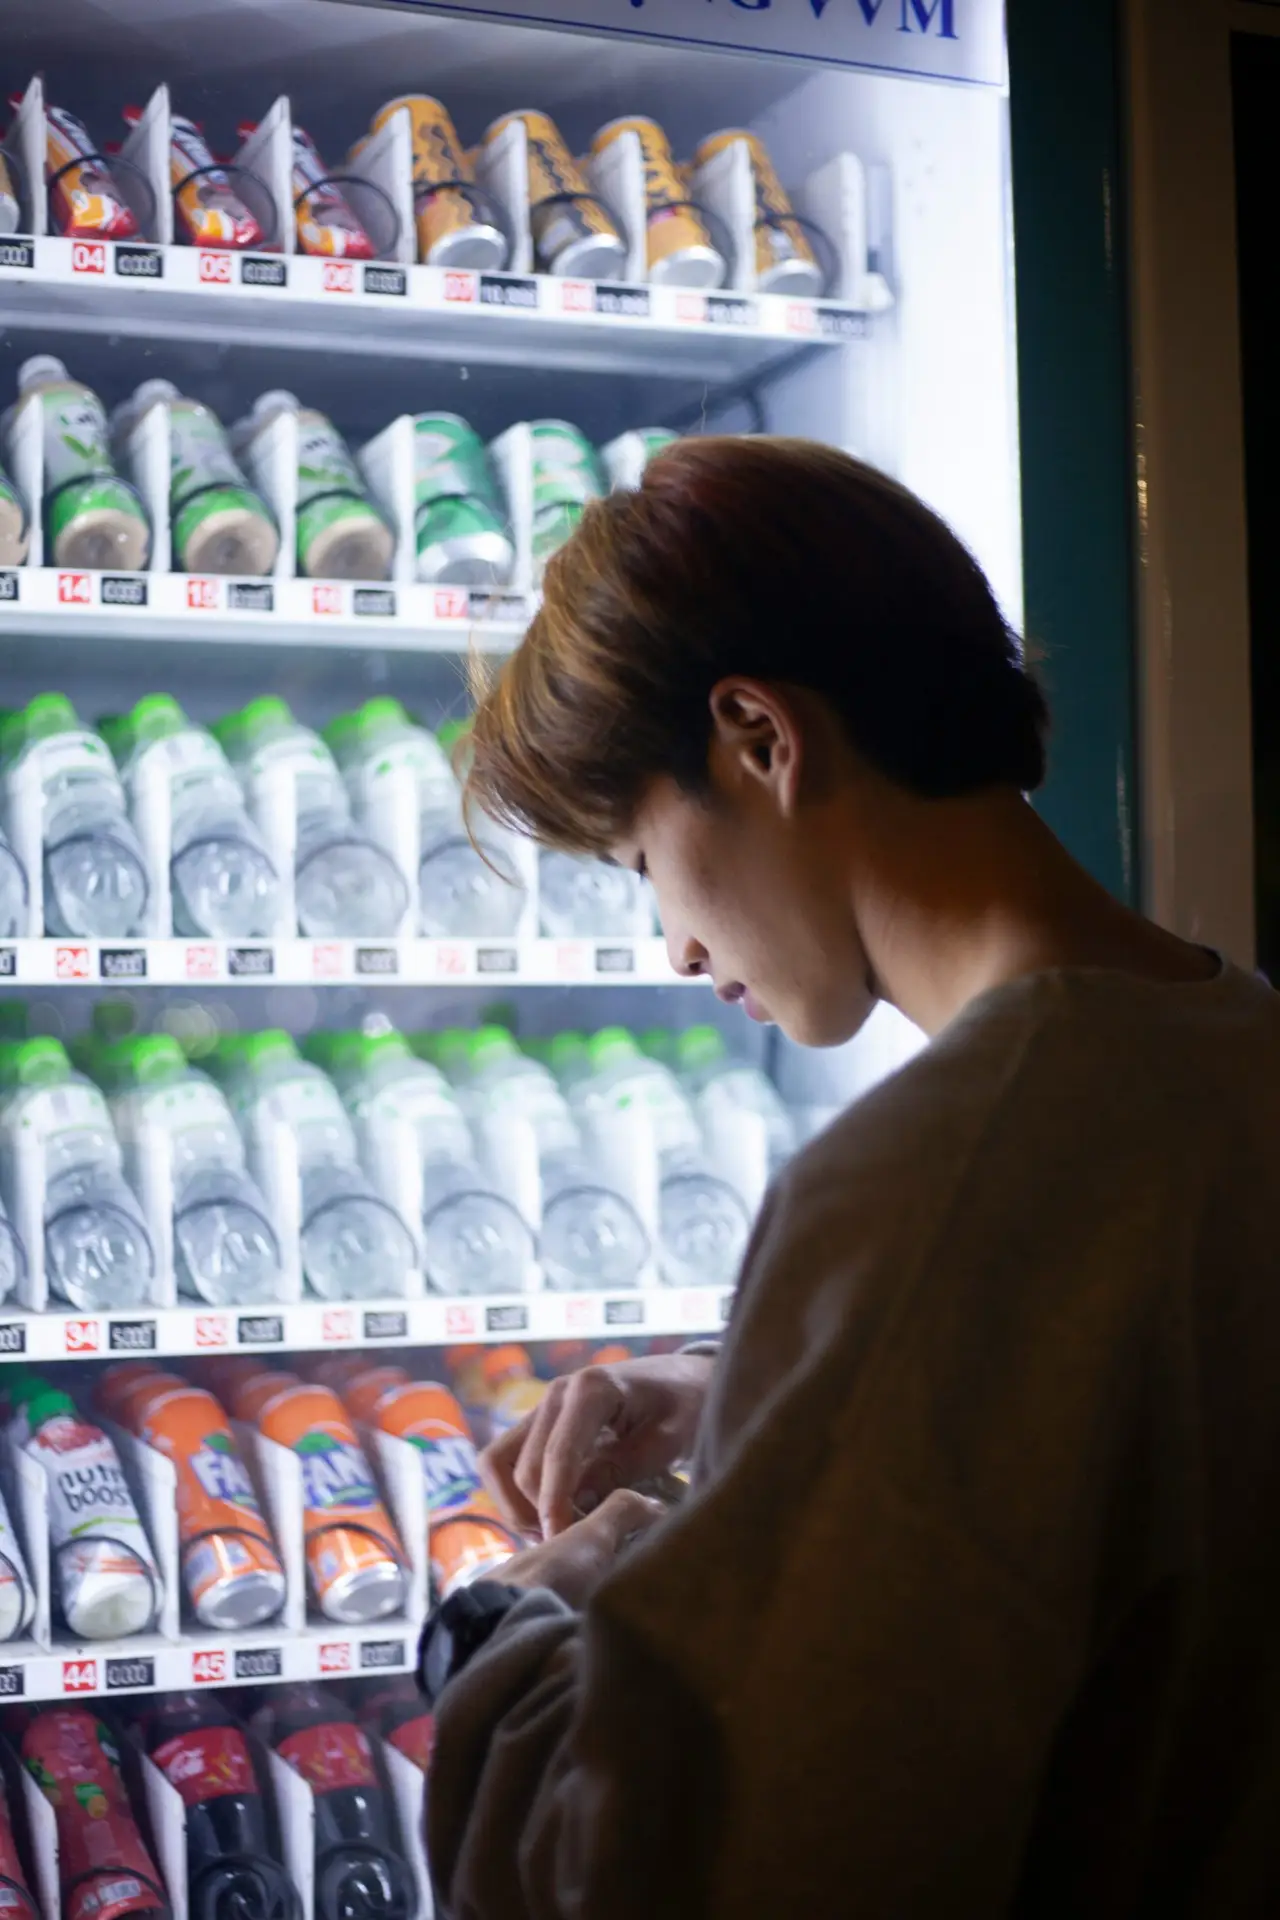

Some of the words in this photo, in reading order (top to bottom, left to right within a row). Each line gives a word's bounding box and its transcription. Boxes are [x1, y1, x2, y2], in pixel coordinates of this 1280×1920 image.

[73, 244, 105, 271] 04
[60, 575, 90, 602] 14
[63, 1663, 96, 1691] 44
[193, 1652, 225, 1682] 45
